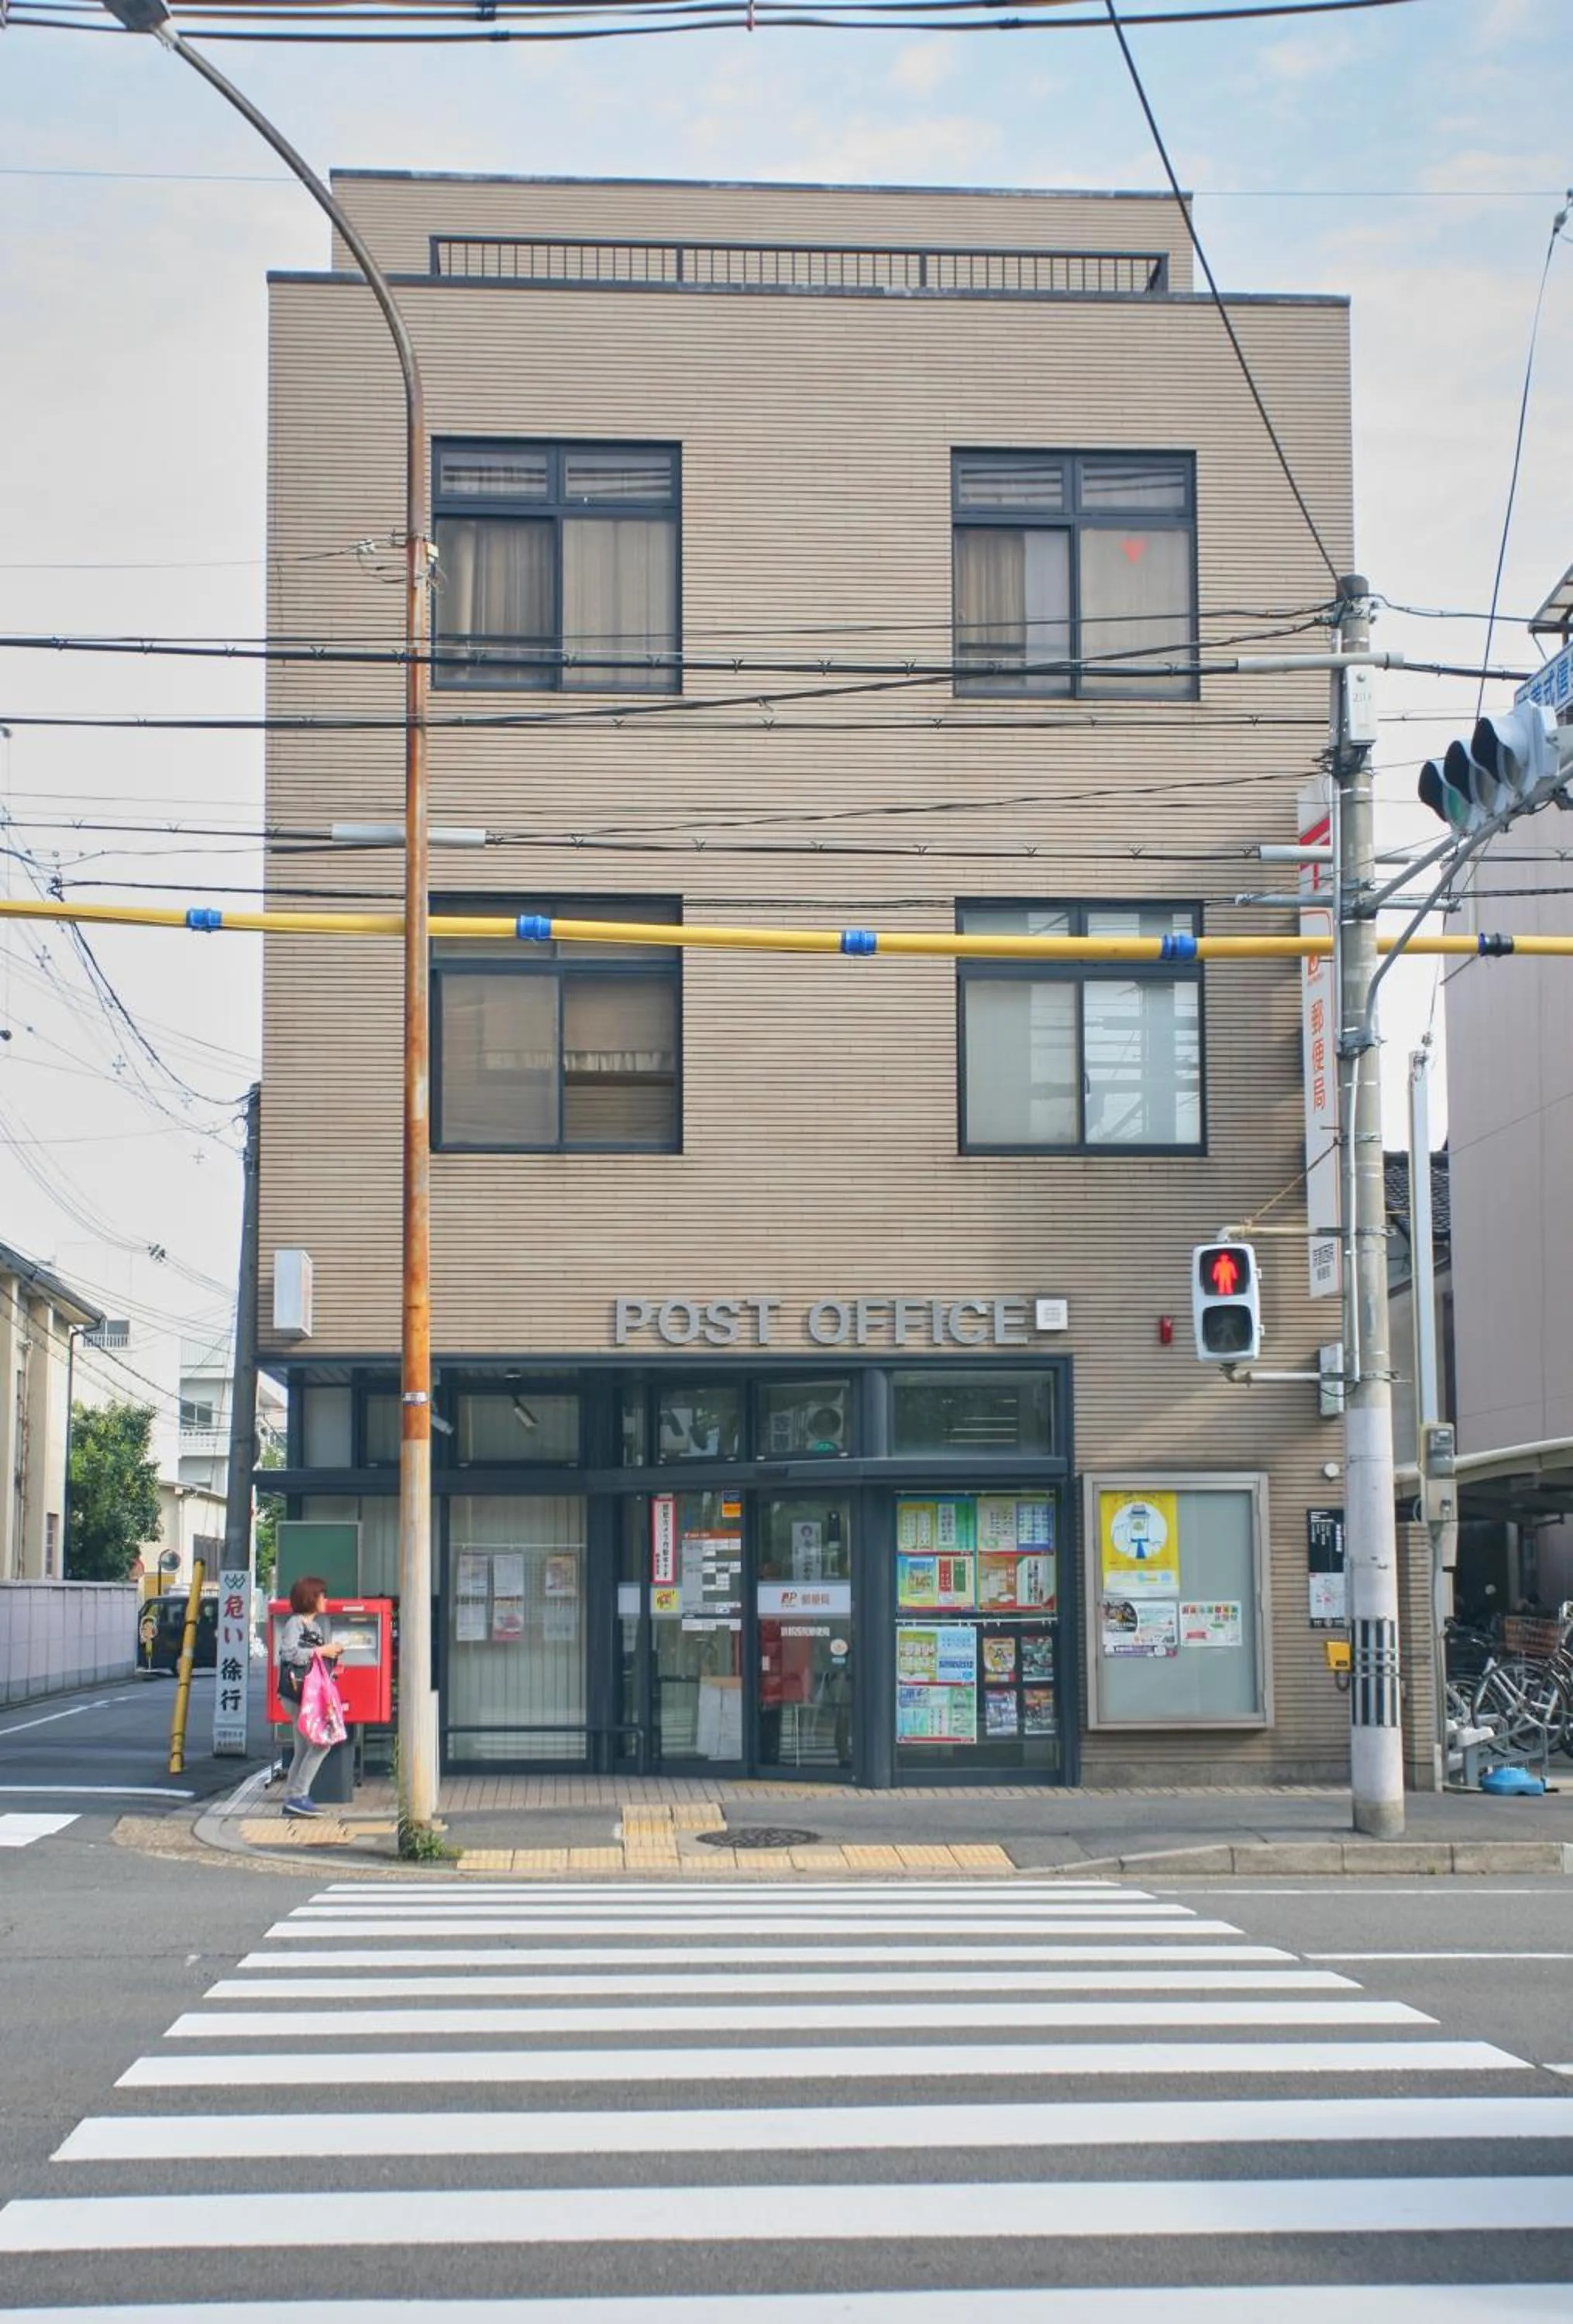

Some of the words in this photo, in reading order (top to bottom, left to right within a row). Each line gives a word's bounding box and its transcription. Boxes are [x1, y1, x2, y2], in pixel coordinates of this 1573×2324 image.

[1311, 999, 1327, 1111] 郵便局
[614, 1297, 781, 1345] POST
[808, 1297, 1028, 1345] OFFICE
